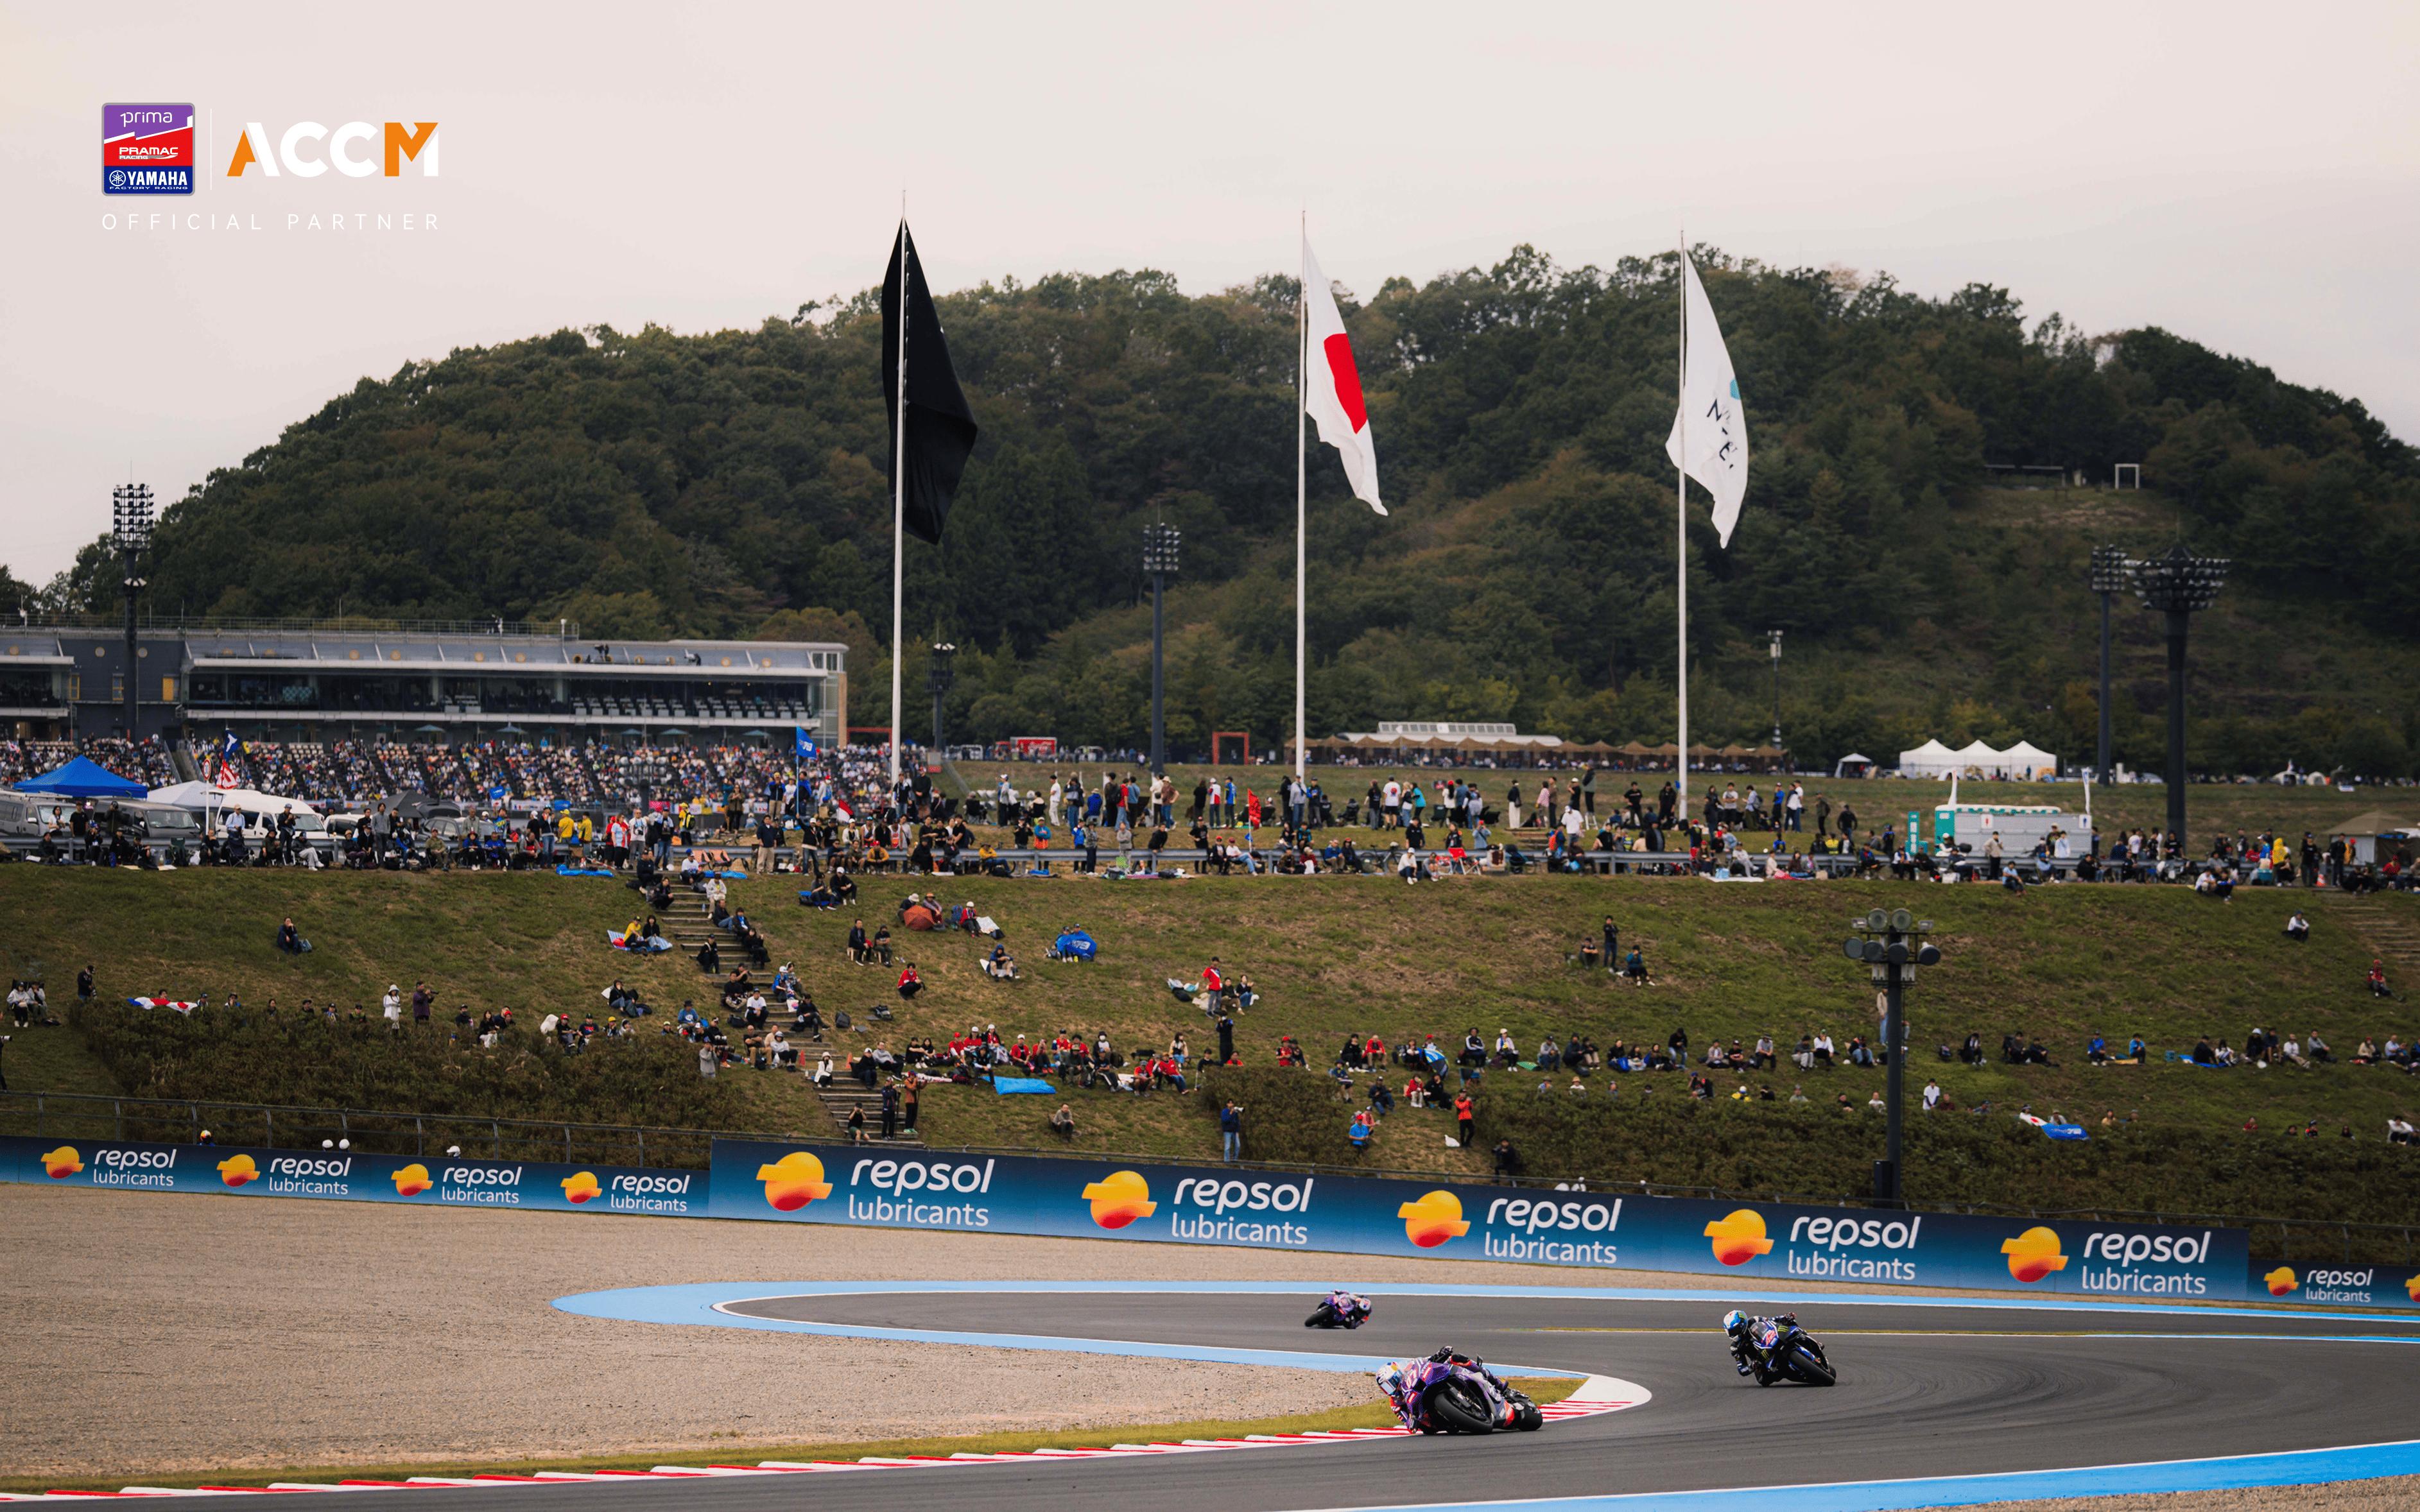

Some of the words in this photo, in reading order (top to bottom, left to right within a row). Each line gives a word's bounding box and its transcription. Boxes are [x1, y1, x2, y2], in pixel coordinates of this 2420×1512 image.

[94, 1149, 177, 1171] repsol
[270, 1157, 351, 1178] repsol
[93, 1169, 174, 1187] lubricants
[269, 1177, 348, 1195] lubricants
[443, 1166, 522, 1188] repsol
[612, 1174, 690, 1196] repsol
[851, 1158, 995, 1197] repsol
[442, 1186, 519, 1204] lubricants
[610, 1194, 687, 1212] lubricants
[1173, 1178, 1313, 1215] repsol
[849, 1194, 989, 1227] lubricants
[1487, 1198, 1622, 1235] repsol
[1171, 1212, 1308, 1245] lubricants
[1790, 1216, 1921, 1252] repsol
[1484, 1232, 1617, 1264] lubricants
[2084, 1231, 2211, 1267] repsol
[1788, 1250, 1915, 1281] lubricants
[2082, 1266, 2206, 1294] lubricants
[2307, 1269, 2373, 1288] repsol
[2306, 1289, 2371, 1303] lubricants
